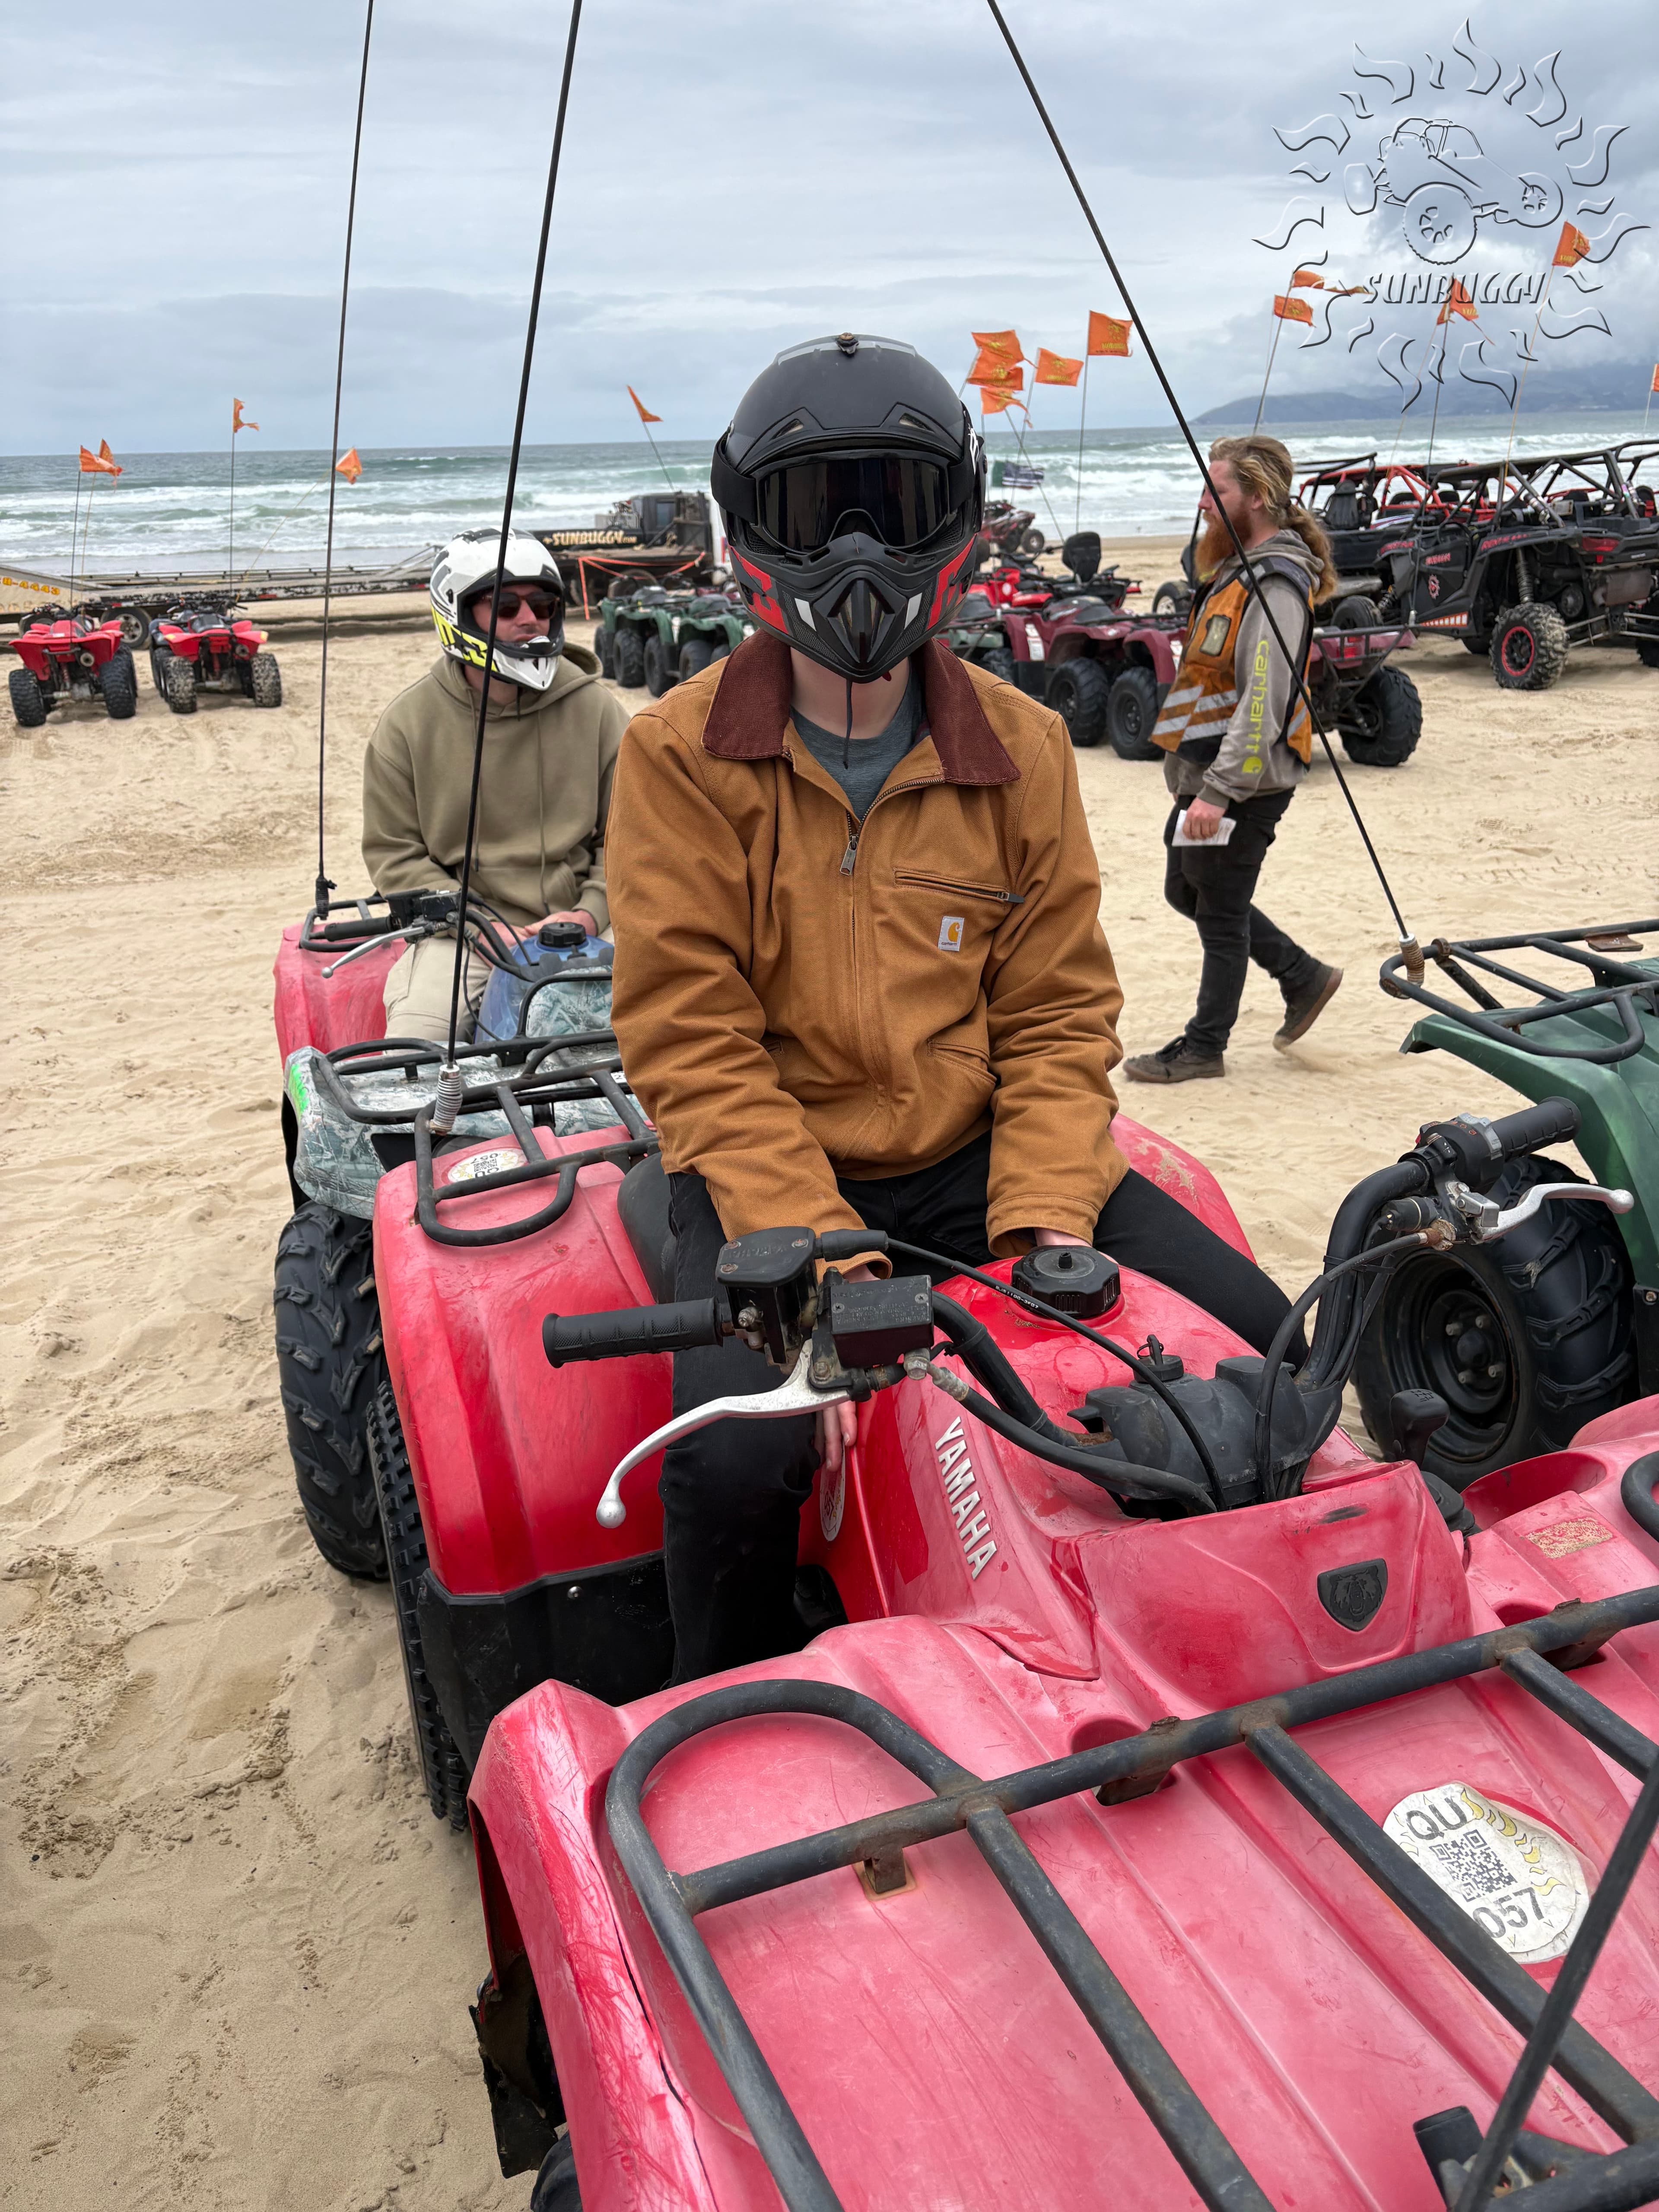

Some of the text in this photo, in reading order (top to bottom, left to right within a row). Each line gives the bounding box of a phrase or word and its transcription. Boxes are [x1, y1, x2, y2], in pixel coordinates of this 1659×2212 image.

[935, 1416, 997, 1580] YAMAHA
[1406, 1797, 1468, 1840] QU
[1472, 1887, 1545, 1939] 057
